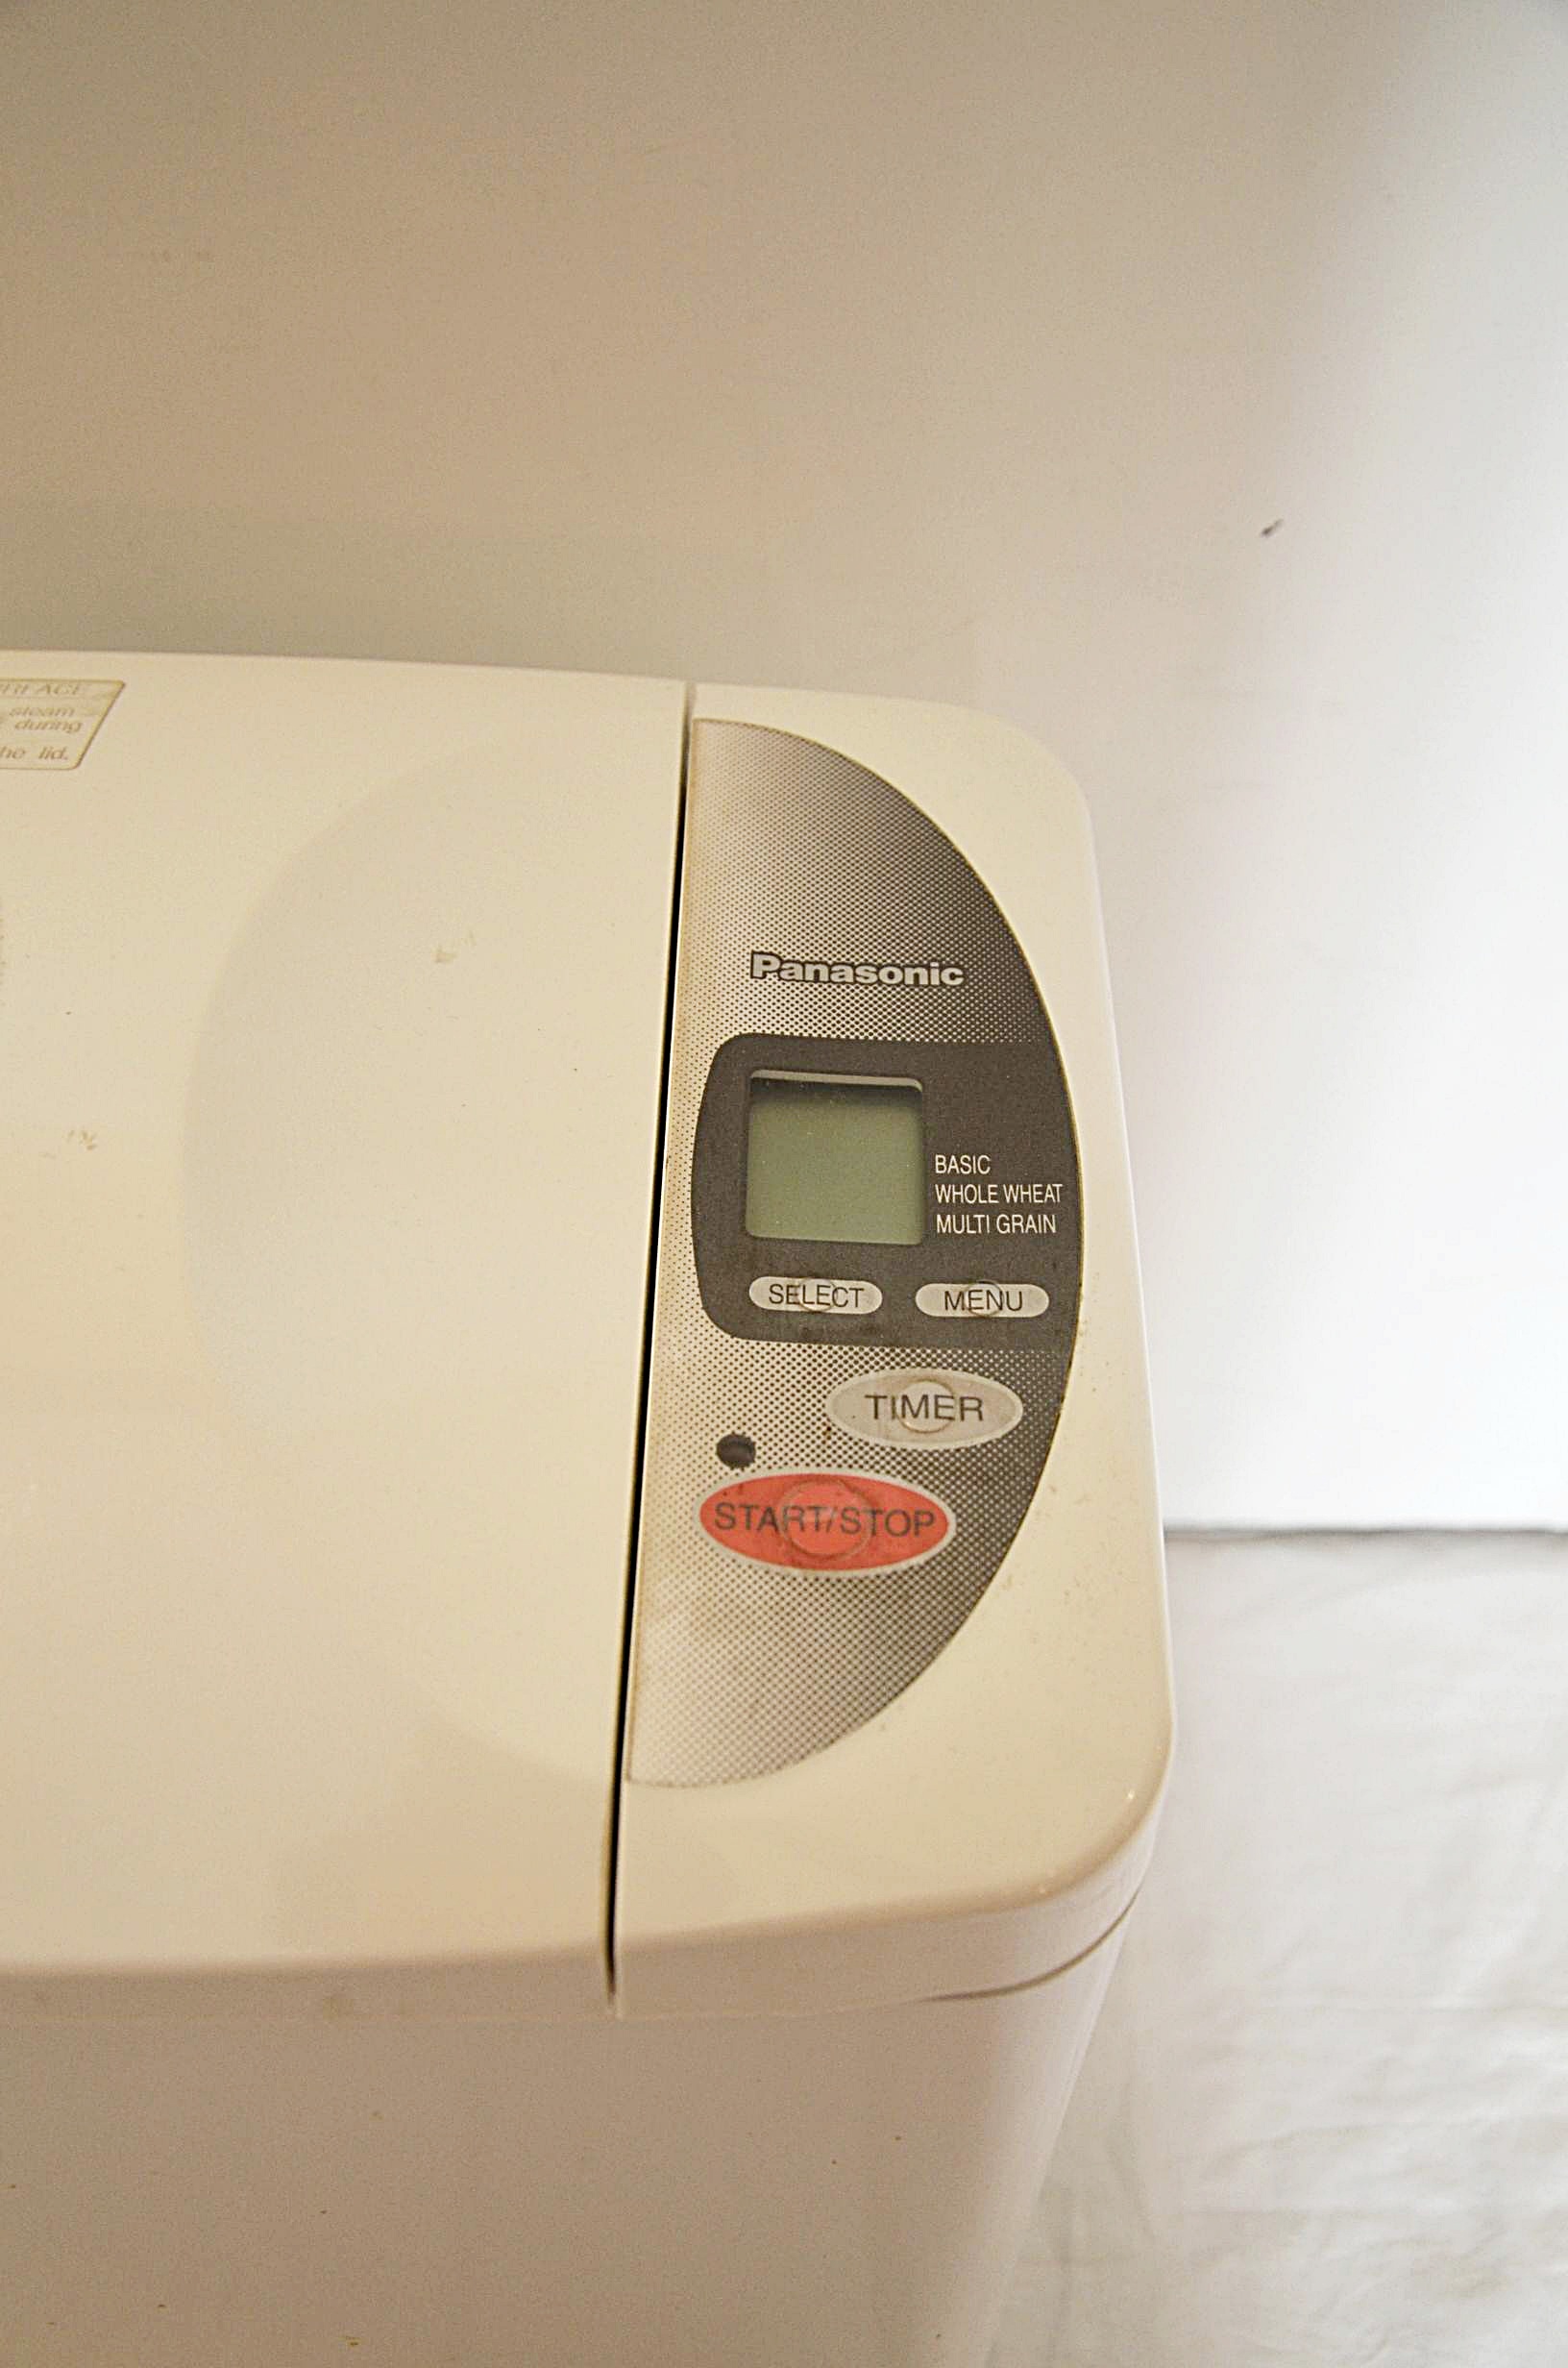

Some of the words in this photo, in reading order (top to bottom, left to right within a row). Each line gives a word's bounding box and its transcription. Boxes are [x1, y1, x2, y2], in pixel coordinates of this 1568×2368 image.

[0, 683, 84, 695] RFACE
[14, 719, 83, 734] during
[0, 746, 26, 759] he
[37, 747, 68, 760] lid.
[750, 950, 965, 986] Panasonic
[935, 1154, 991, 1174] BASIC
[935, 1183, 998, 1204] WHOLE
[1003, 1183, 1064, 1204] WHEAT
[936, 1214, 991, 1234] MULTI
[995, 1214, 1057, 1234] GRAIN
[768, 1283, 865, 1309] SELECT
[943, 1289, 1023, 1312] MENU
[865, 1394, 984, 1422] TIMER
[714, 1502, 936, 1537] START/STOP
